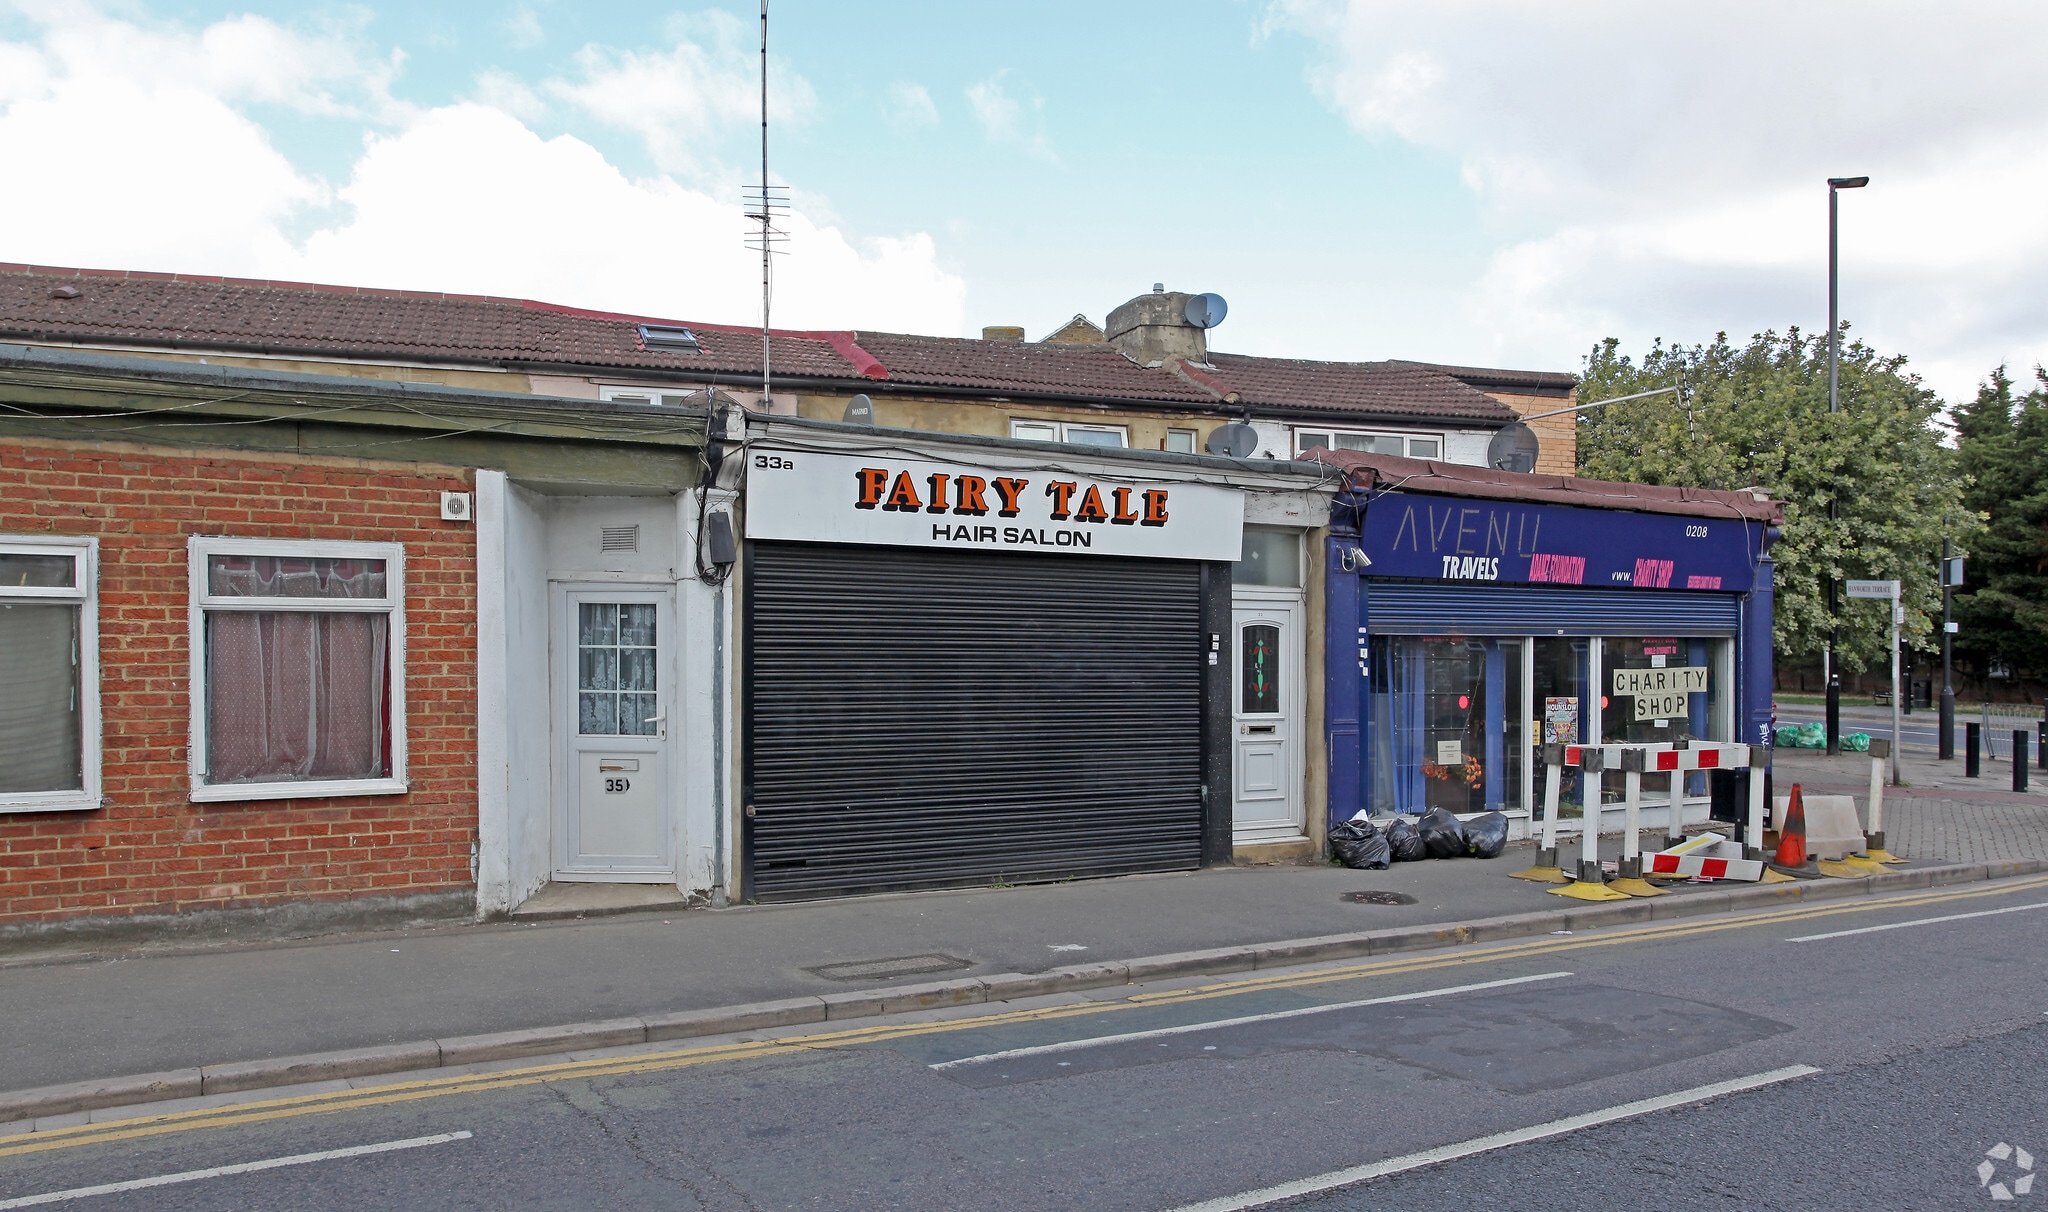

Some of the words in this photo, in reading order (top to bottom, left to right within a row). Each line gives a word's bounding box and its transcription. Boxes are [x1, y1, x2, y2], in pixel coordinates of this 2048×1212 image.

[755, 455, 794, 470] 33a
[854, 467, 1028, 518] FAIRY
[1046, 479, 1169, 527] TALE
[932, 523, 998, 543] HAIR
[1003, 526, 1092, 548] SALON
[1685, 525, 1708, 539] 0208
[1442, 555, 1499, 581] TRAVELS
[1616, 671, 1705, 692] CHARITY
[1637, 696, 1685, 716] SHOP
